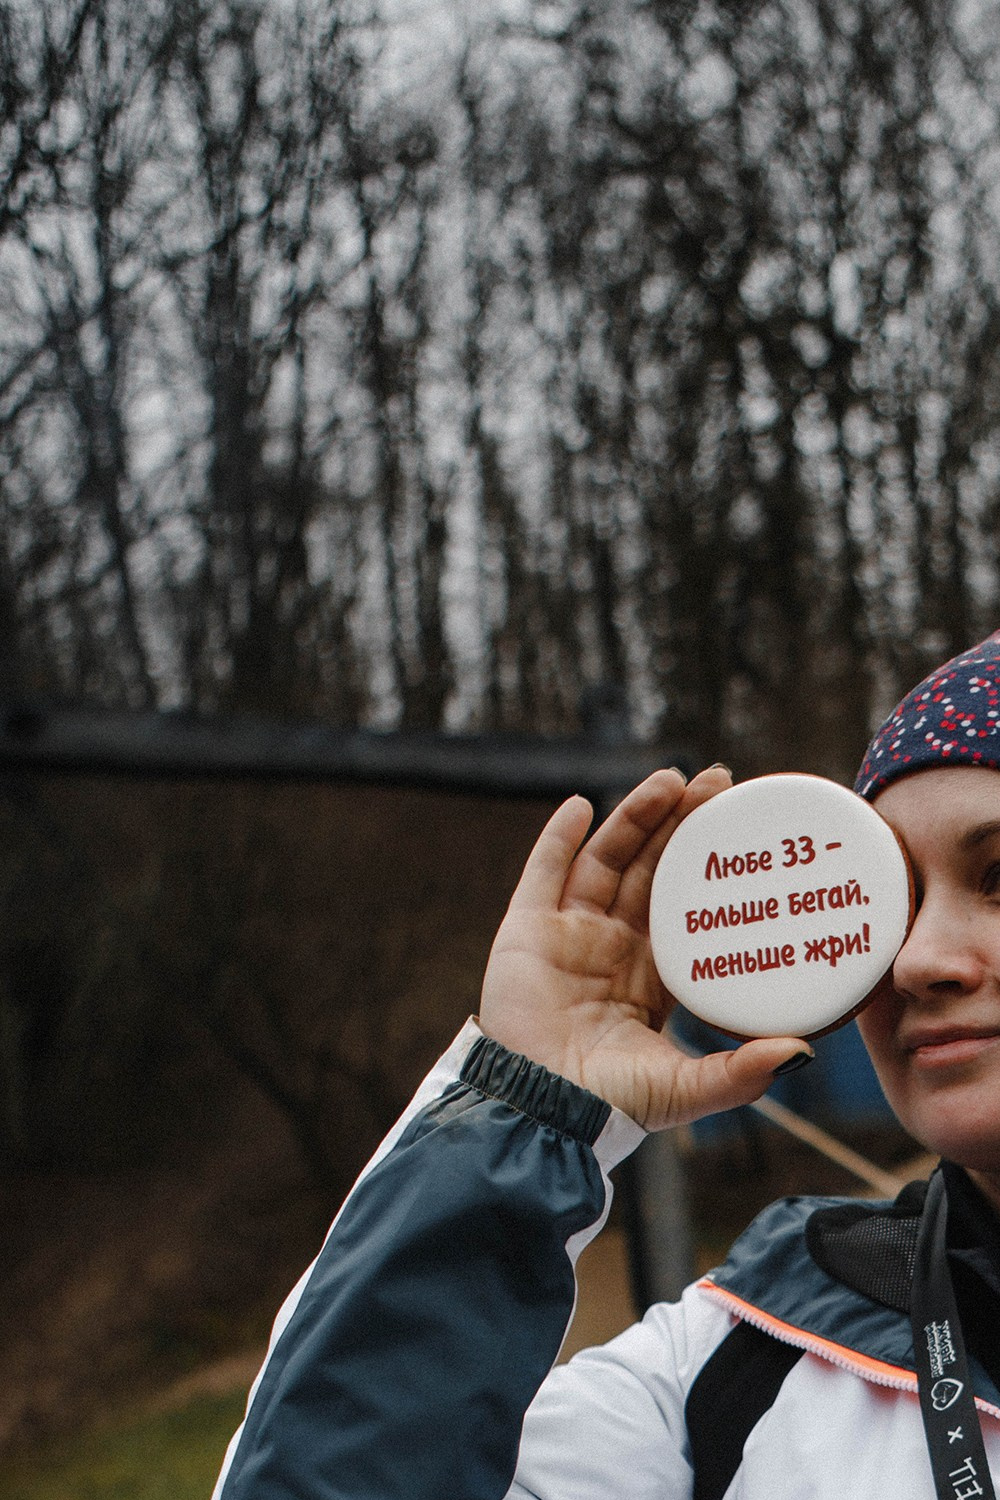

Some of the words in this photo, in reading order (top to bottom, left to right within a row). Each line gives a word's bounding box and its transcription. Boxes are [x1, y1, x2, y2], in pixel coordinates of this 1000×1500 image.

[704, 850, 773, 881] Любе
[781, 836, 816, 868] 33
[691, 944, 796, 982] меньше
[803, 922, 871, 968] жри!
